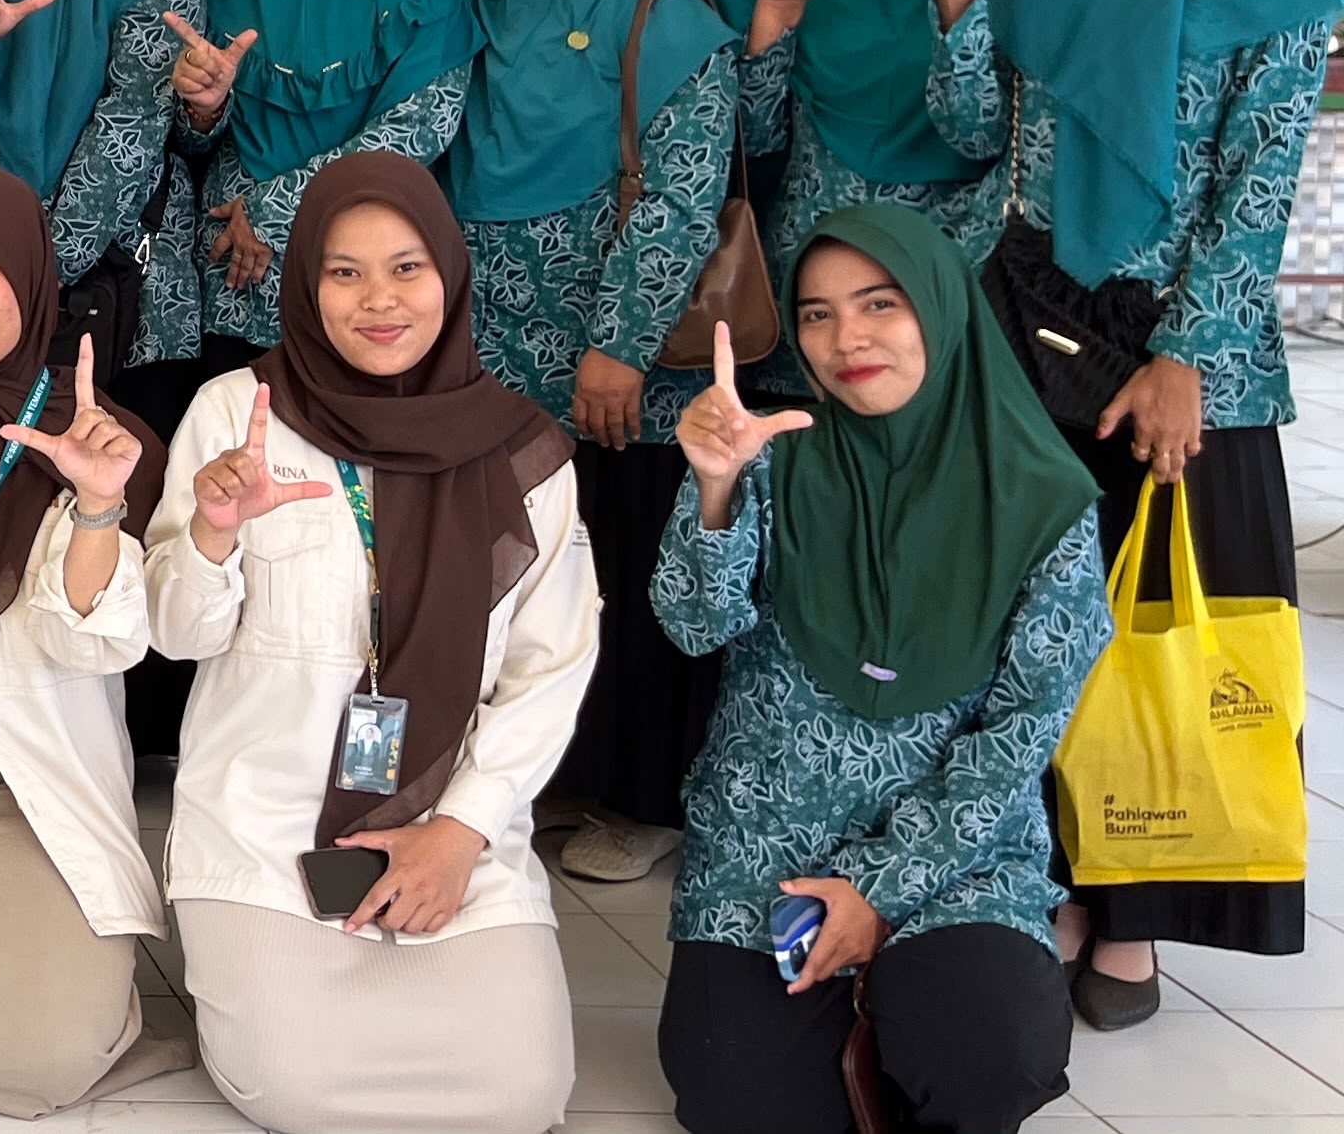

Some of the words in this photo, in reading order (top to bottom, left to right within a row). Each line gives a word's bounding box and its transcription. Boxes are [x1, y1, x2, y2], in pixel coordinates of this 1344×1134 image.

[272, 463, 309, 480] RINA
[1209, 703, 1274, 721] AHLAWAN
[1103, 806, 1188, 821] Pahlawan
[1104, 821, 1147, 835] Bumi
